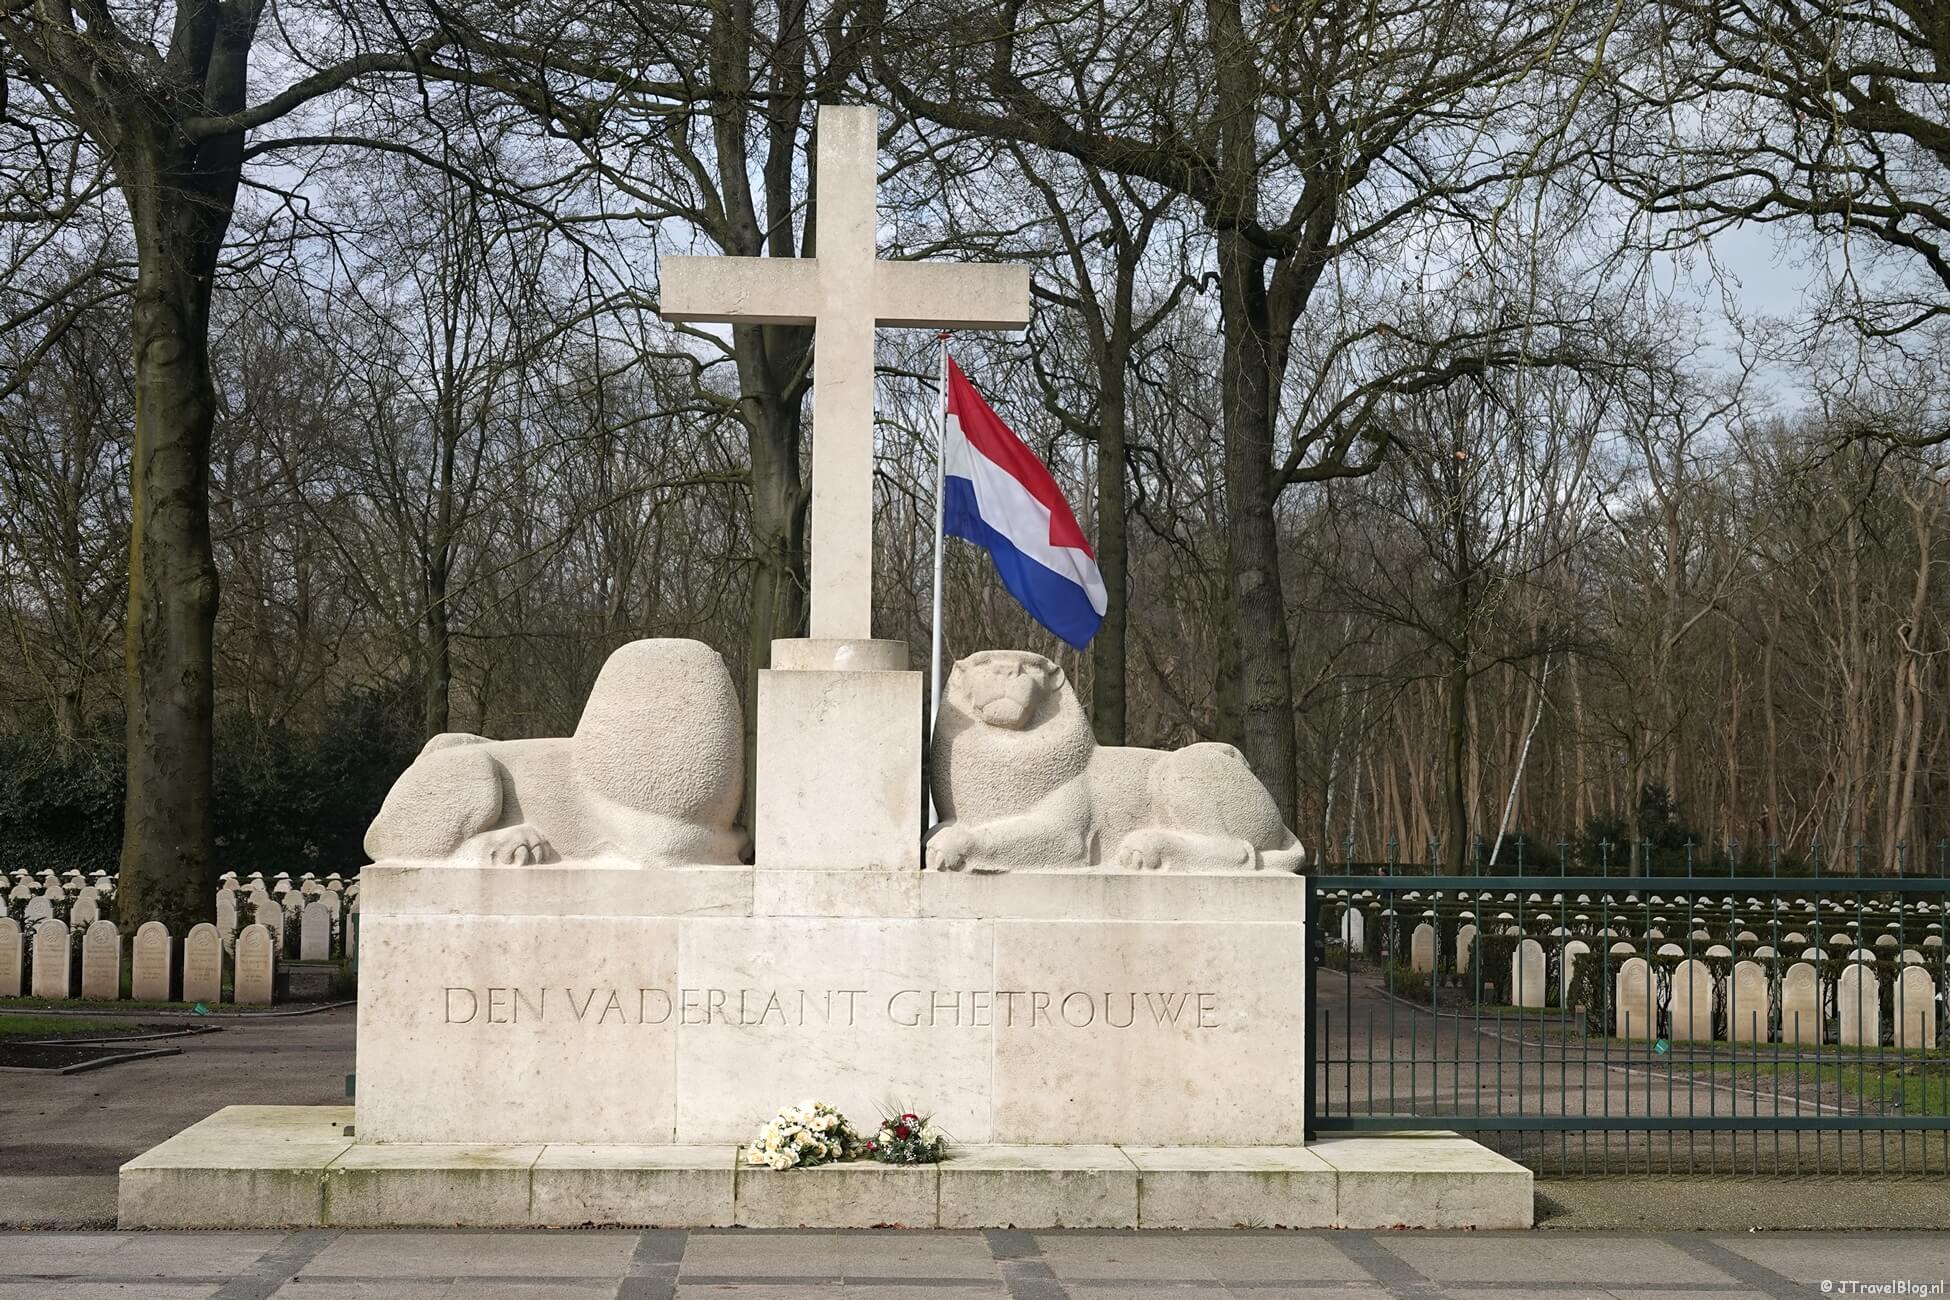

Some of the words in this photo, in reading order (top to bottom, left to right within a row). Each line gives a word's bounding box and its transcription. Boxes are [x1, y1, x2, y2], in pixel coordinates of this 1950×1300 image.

[442, 987, 546, 1025] DEN
[566, 988, 868, 1026] VADERLANT
[887, 989, 1222, 1028] GHETROUWE
